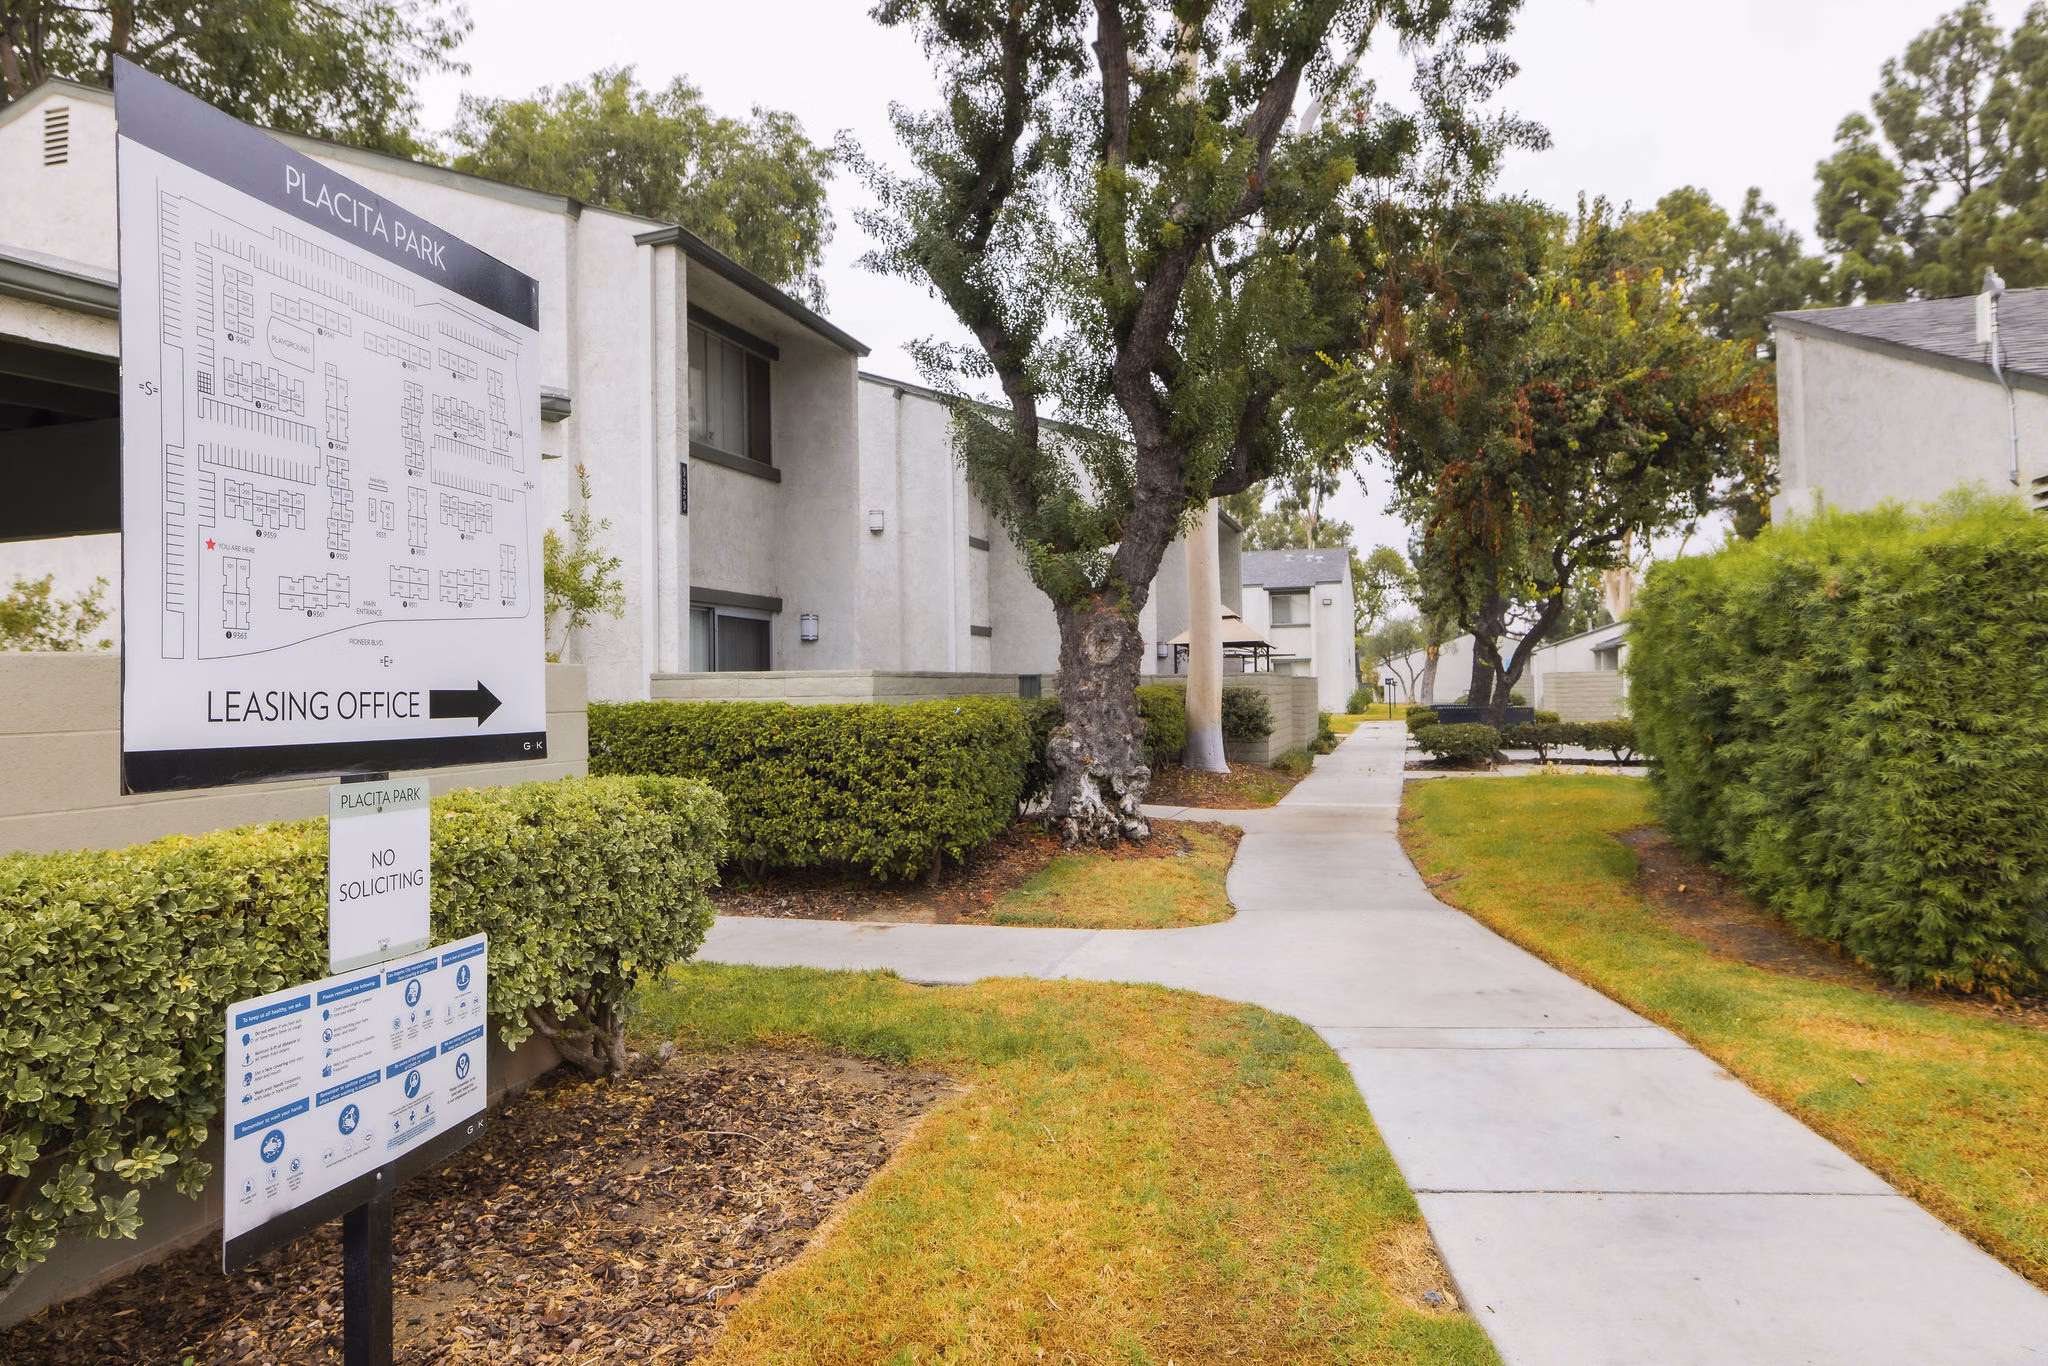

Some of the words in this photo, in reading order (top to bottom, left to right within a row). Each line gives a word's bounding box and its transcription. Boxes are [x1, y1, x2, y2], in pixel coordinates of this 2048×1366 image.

[285, 164, 388, 248] PLACITA
[395, 221, 447, 272] PARK
[236, 336, 250, 346] 9345
[272, 335, 310, 353] PLAYGROUND
[208, 691, 329, 722] LEASING
[338, 691, 419, 719] OFFICE
[341, 791, 390, 809] PLACITA
[394, 787, 420, 803] PARK
[372, 849, 395, 869] NO
[340, 869, 423, 902] SOLICITING
[335, 988, 352, 997] remember
[320, 1088, 339, 1097] Remember
[242, 1118, 264, 1132] Remember
[271, 1113, 280, 1121] wash
